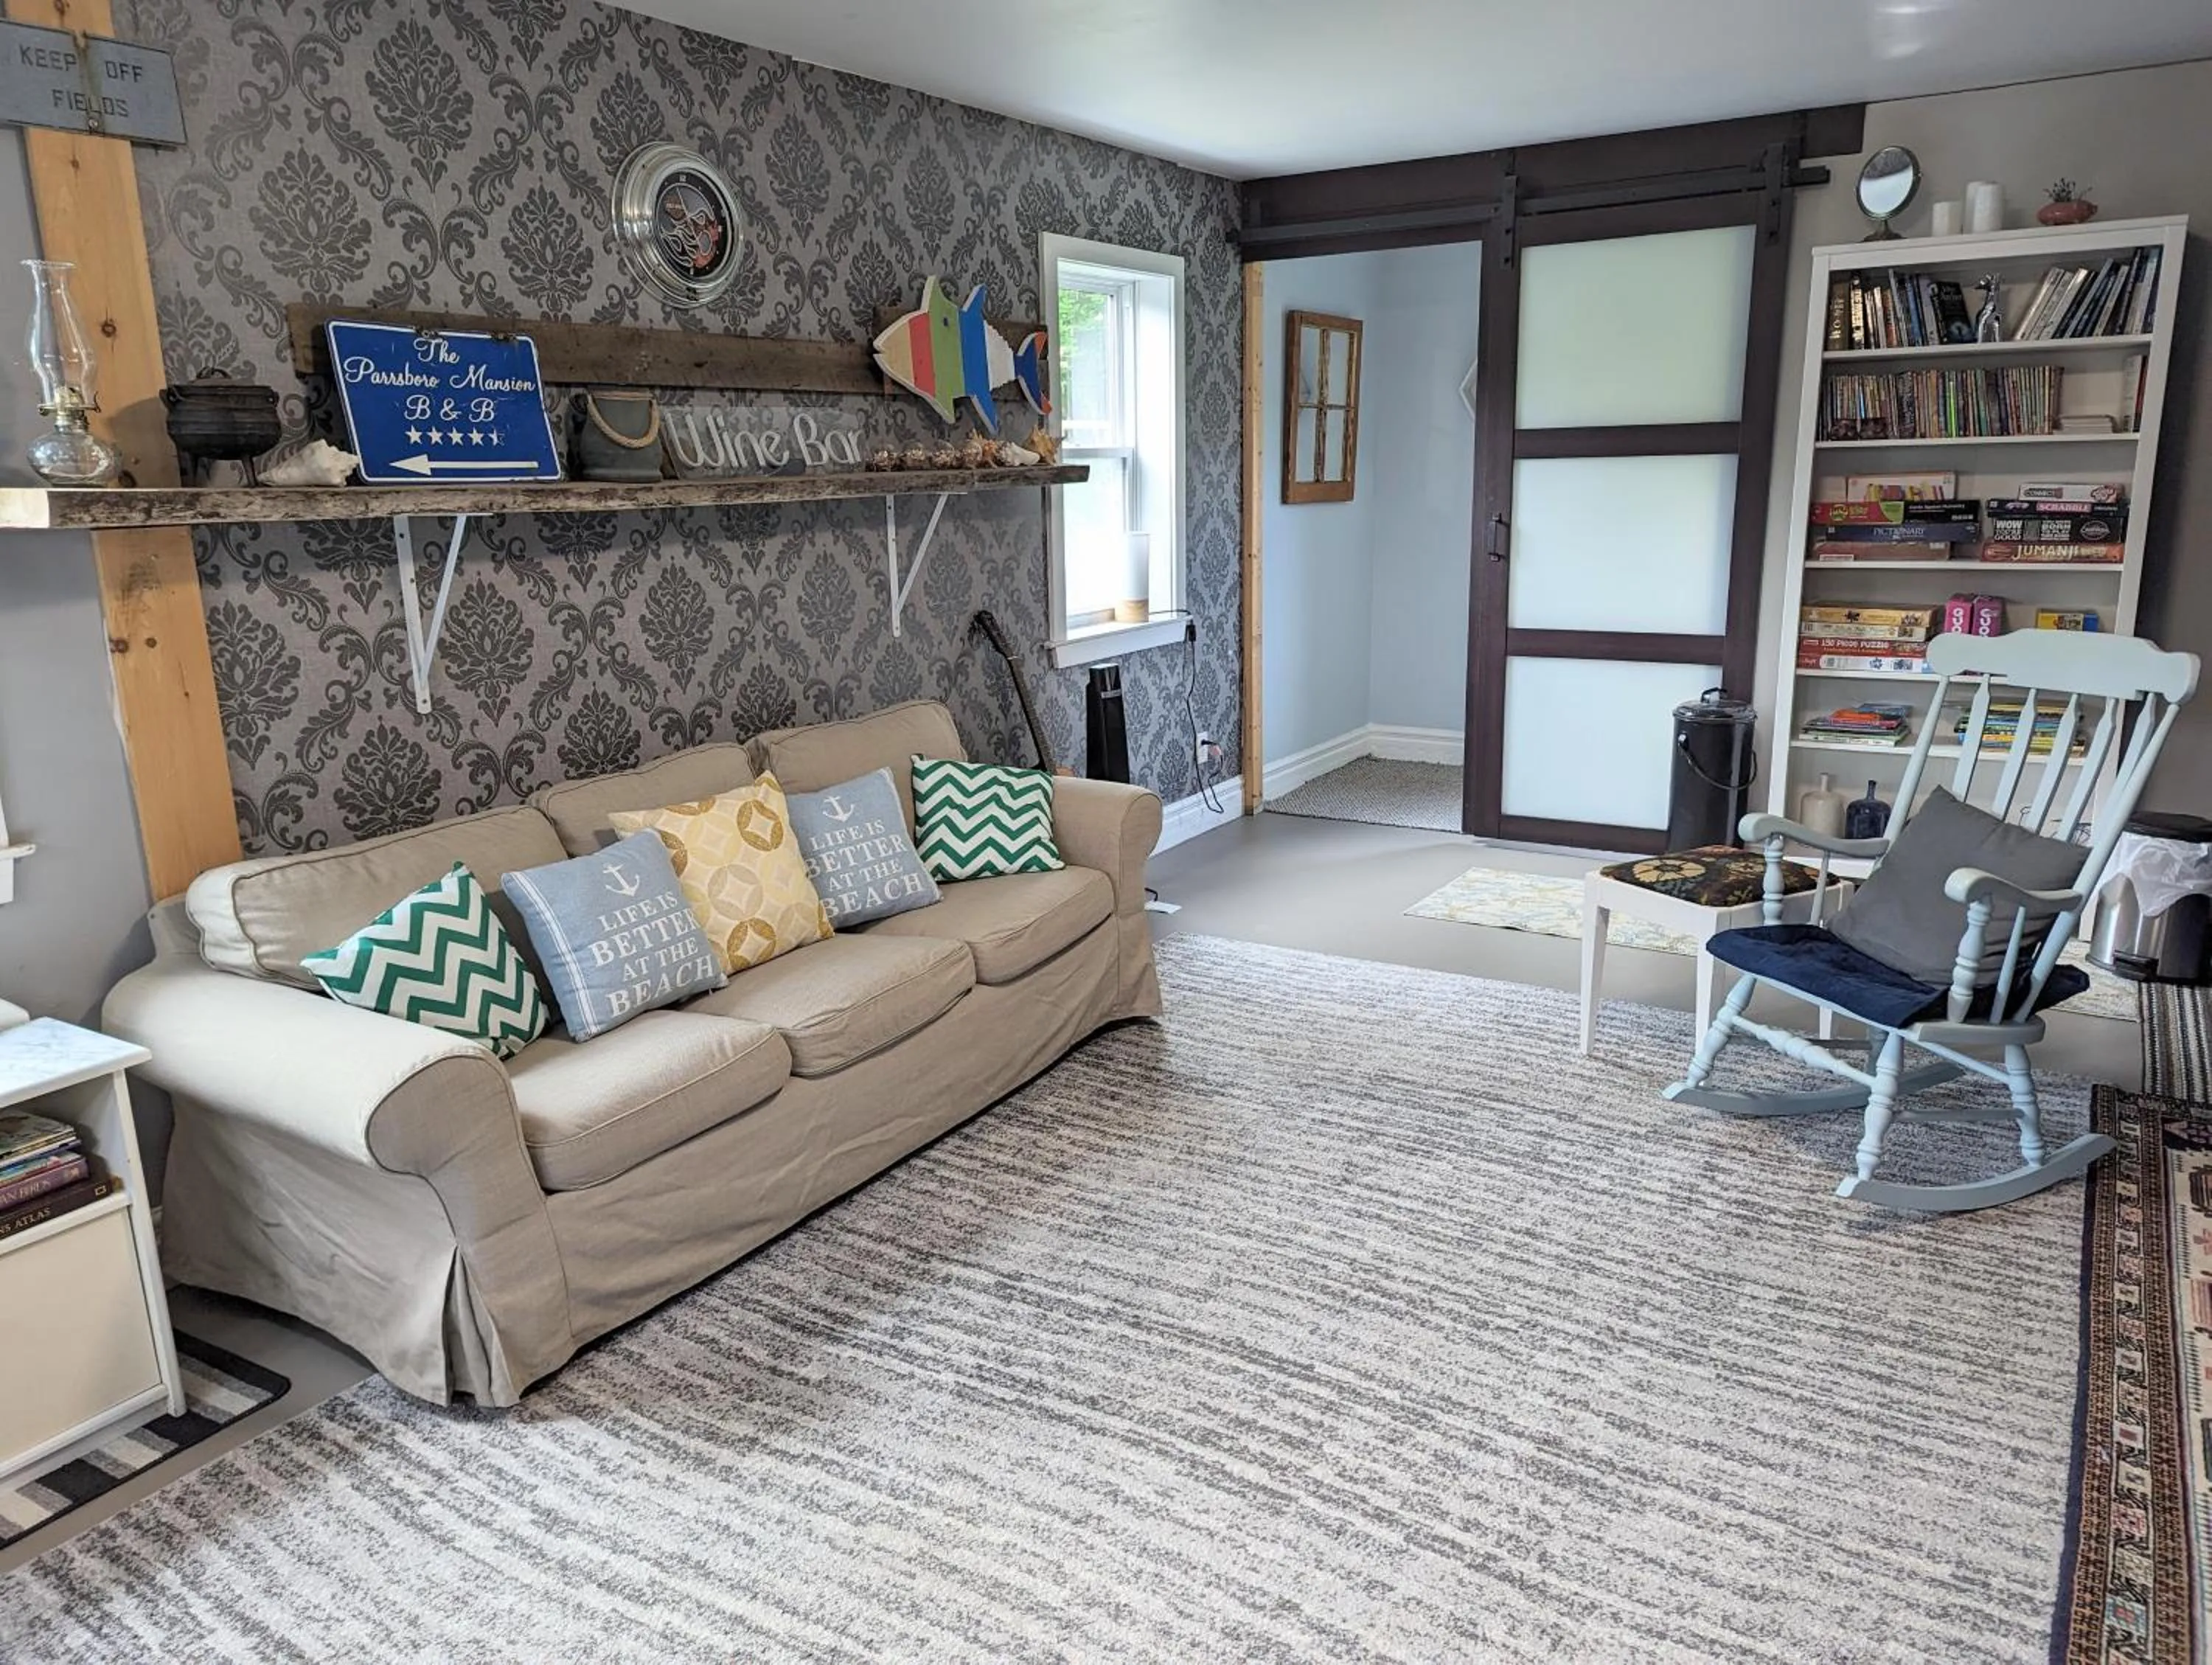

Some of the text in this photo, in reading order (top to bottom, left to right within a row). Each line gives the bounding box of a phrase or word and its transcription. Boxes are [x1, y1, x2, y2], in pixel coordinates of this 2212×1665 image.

[20, 44, 142, 83] KEEP OFF
[52, 88, 129, 118] FIELDS
[414, 338, 460, 364] The
[344, 356, 535, 392] Parrsboro Mansion
[405, 394, 496, 423] B & B
[664, 411, 863, 468] Wine Bar
[1996, 520, 2023, 529] WOW
[2012, 544, 2079, 560] JUMANJI
[810, 819, 886, 851] LIFE IS
[804, 834, 908, 880] BETTER
[828, 858, 903, 891] AT THE
[598, 891, 678, 932] LIFE IS
[820, 873, 923, 918] BEACH
[588, 908, 700, 967] BETTER
[622, 937, 698, 981] AT THE
[605, 956, 714, 1018] BEACH
[15, 1206, 51, 1228] ATLAS
